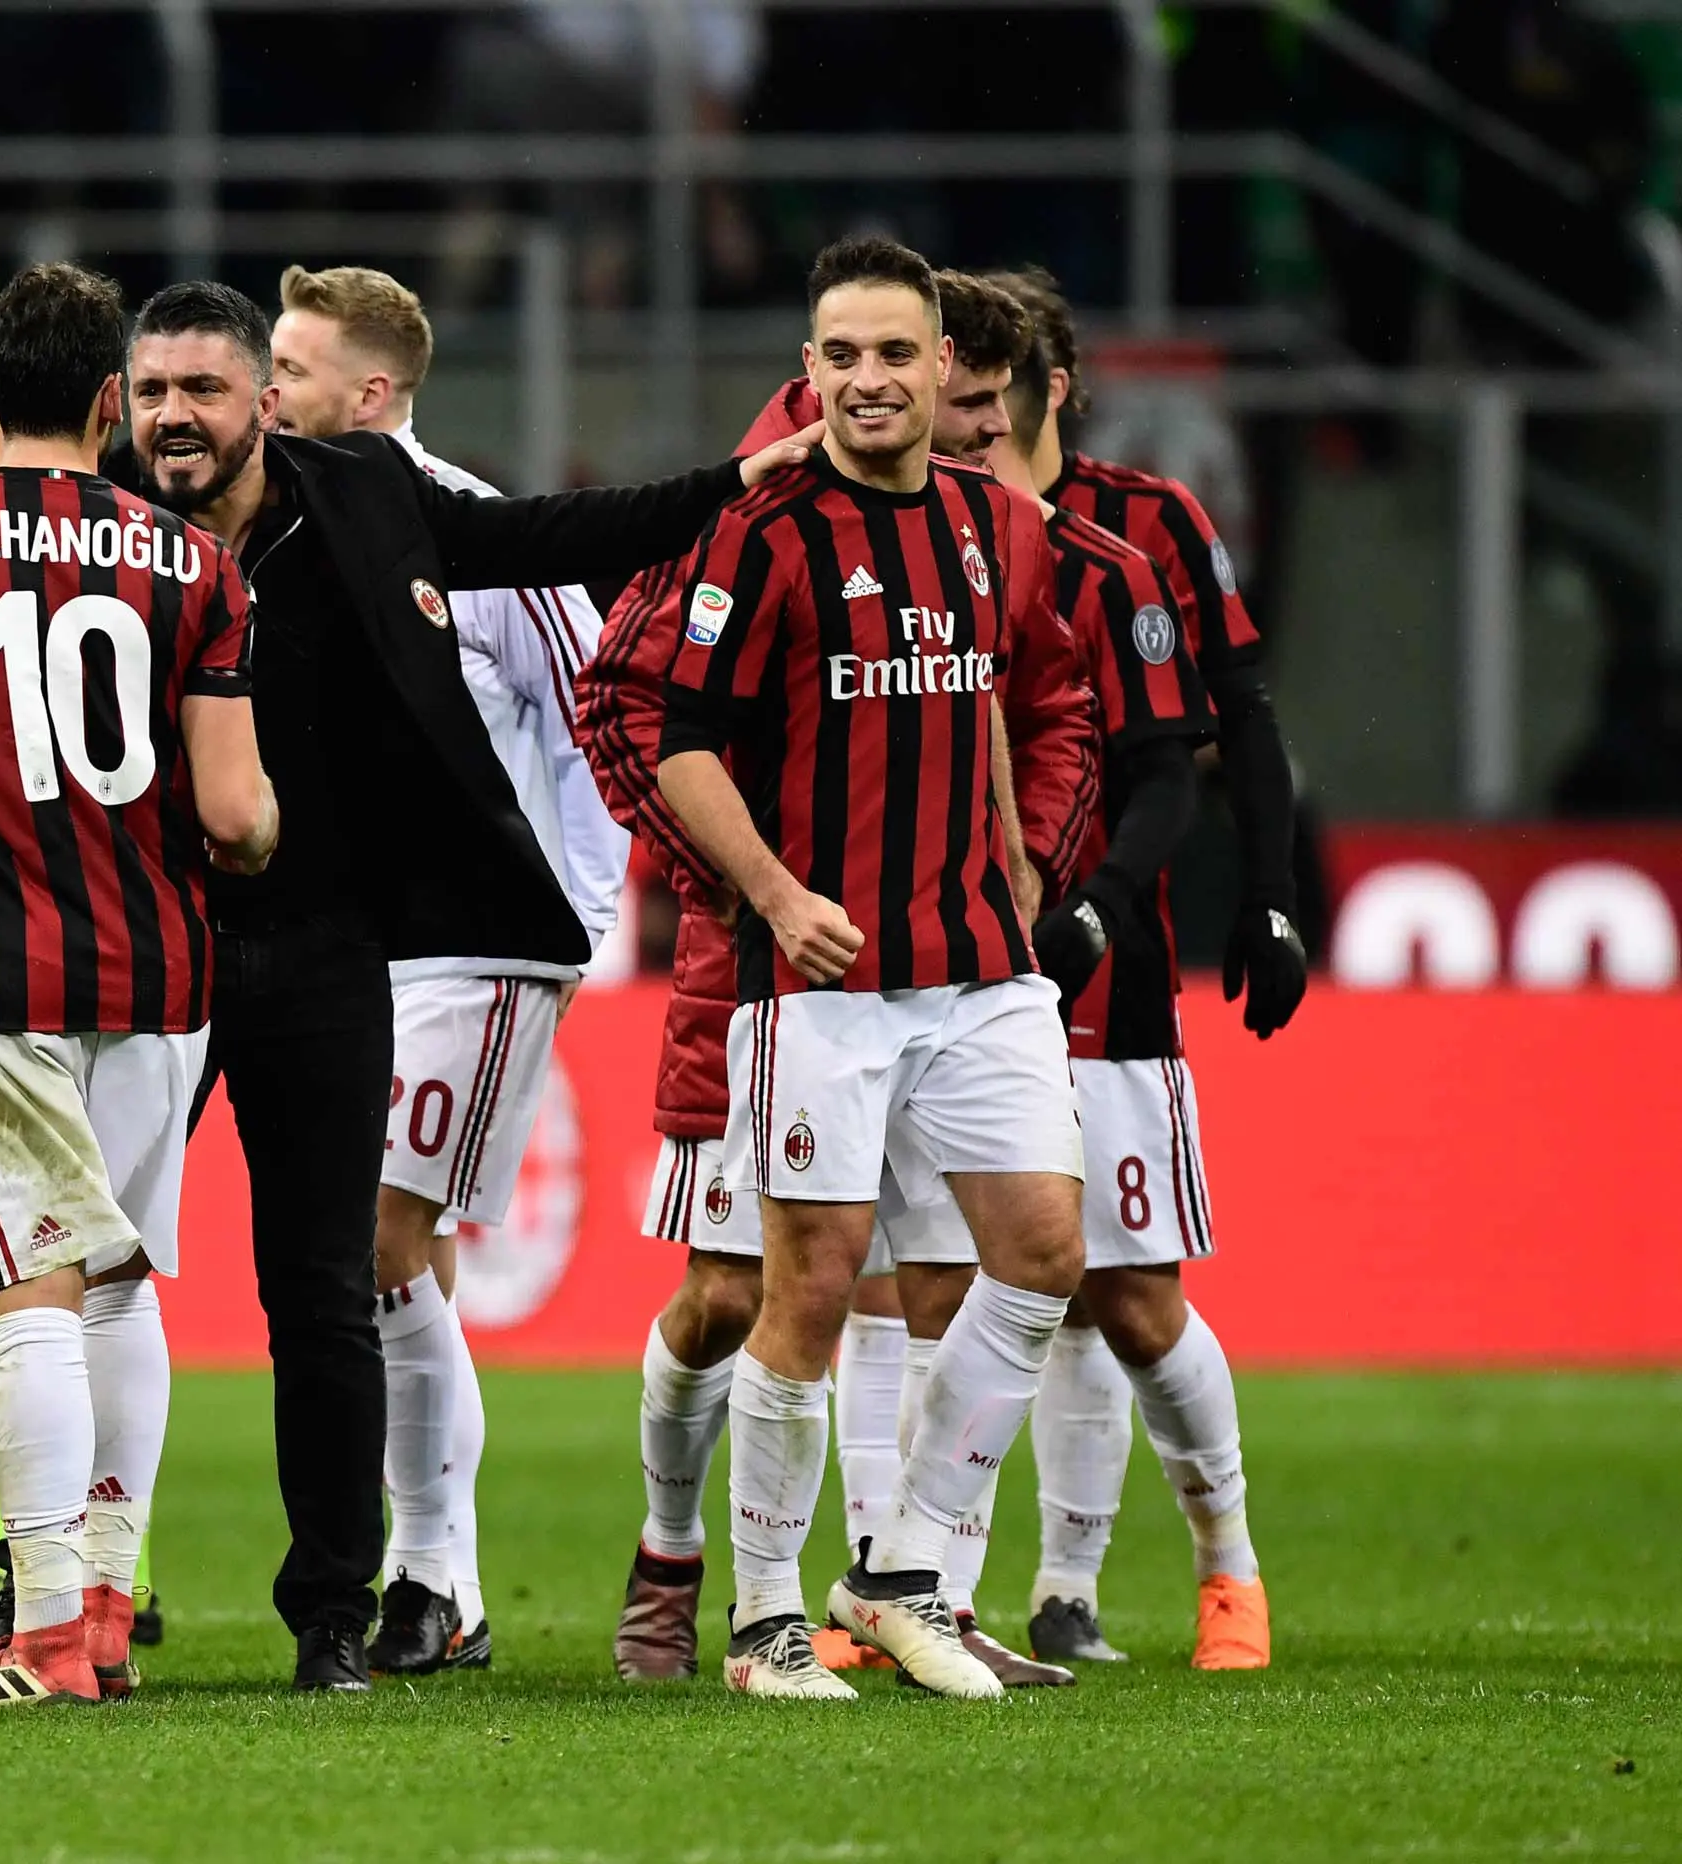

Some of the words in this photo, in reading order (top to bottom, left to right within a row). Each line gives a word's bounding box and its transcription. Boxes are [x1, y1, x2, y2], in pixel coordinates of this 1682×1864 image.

[841, 582, 885, 600] adidas
[898, 605, 955, 646] Fly
[827, 643, 994, 700] Emirate
[1117, 1155, 1152, 1232] 8
[29, 1228, 73, 1251] adidas
[739, 1506, 807, 1530] MILAN
